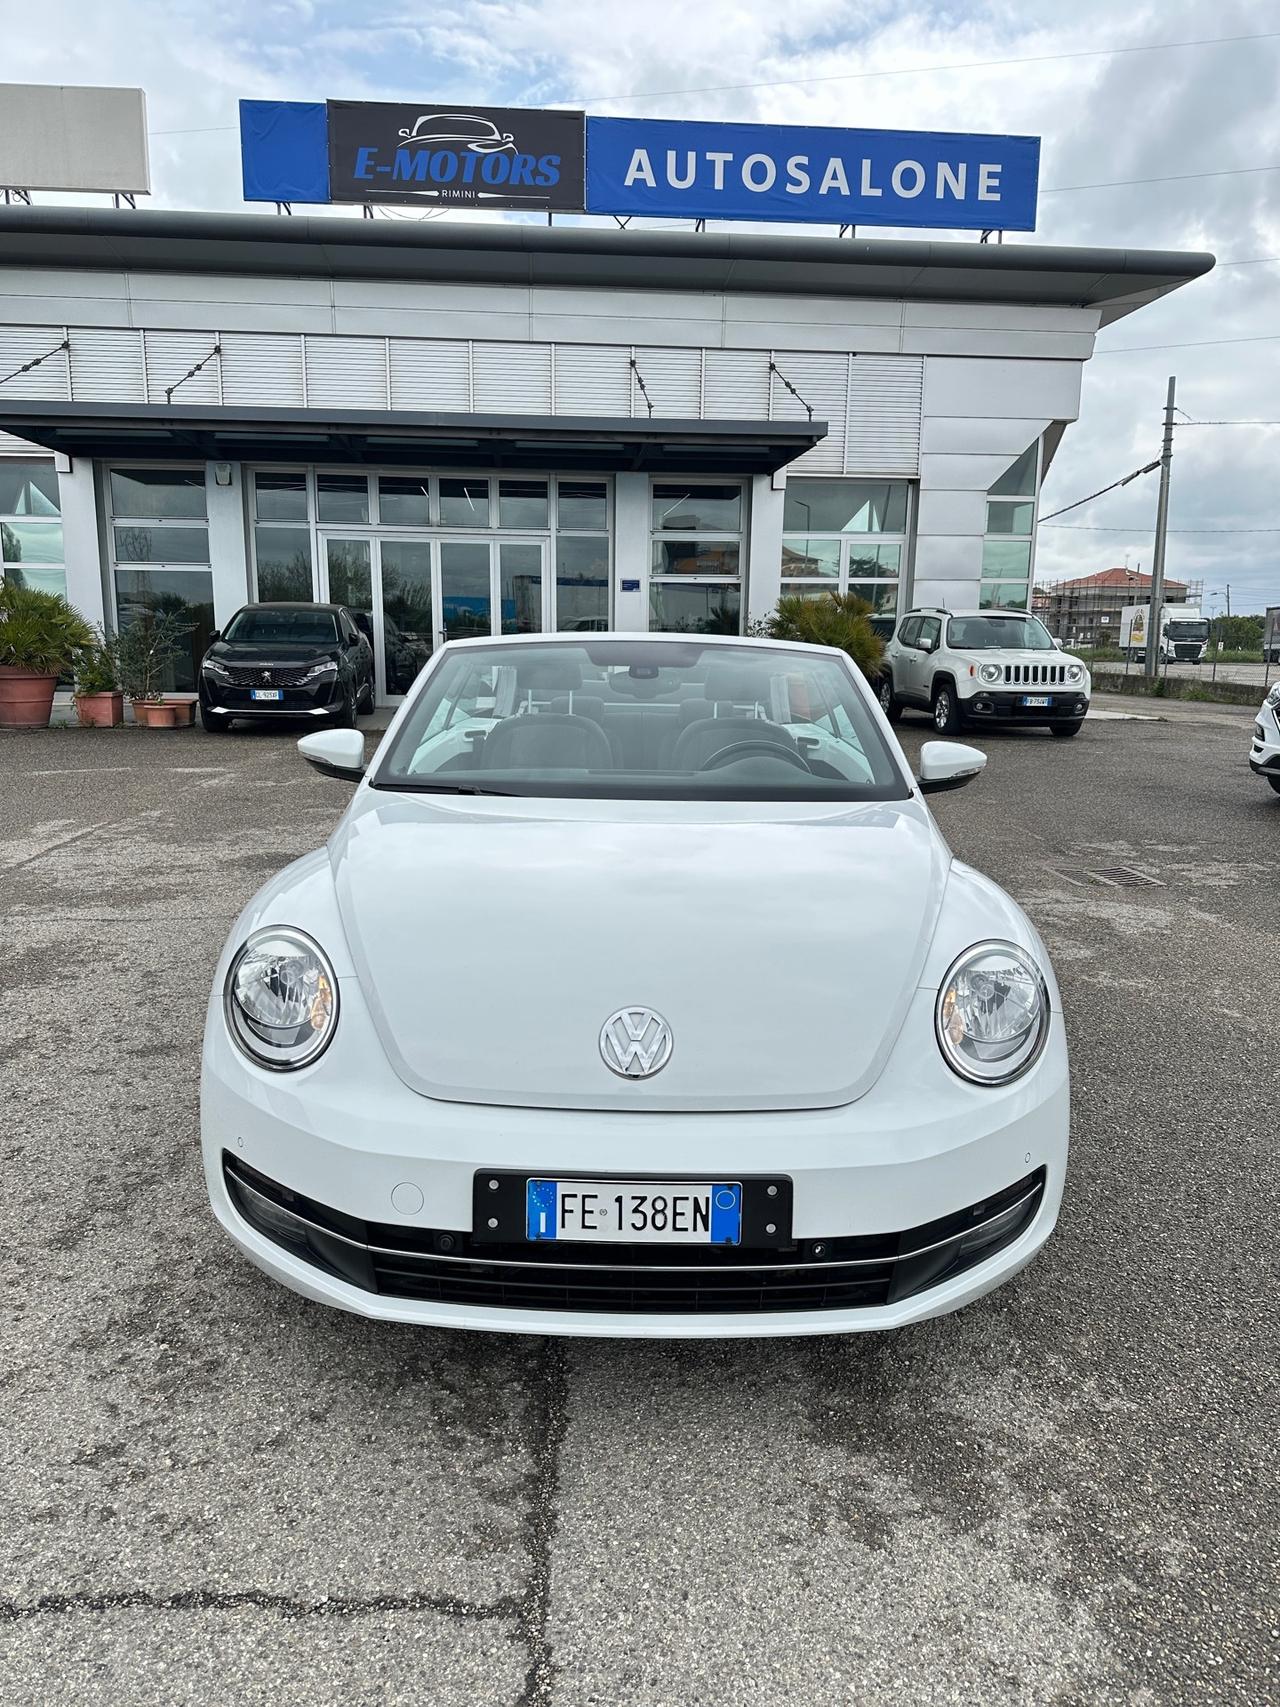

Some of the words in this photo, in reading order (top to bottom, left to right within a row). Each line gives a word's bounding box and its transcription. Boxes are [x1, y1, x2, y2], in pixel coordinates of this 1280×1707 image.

[352, 147, 561, 186] E-MOTORS
[623, 148, 1003, 201] AUTOSALONE
[441, 189, 476, 199] RIMINI
[602, 1008, 670, 1077] VW
[561, 1193, 598, 1230] FE
[614, 1195, 710, 1232] 138EN
